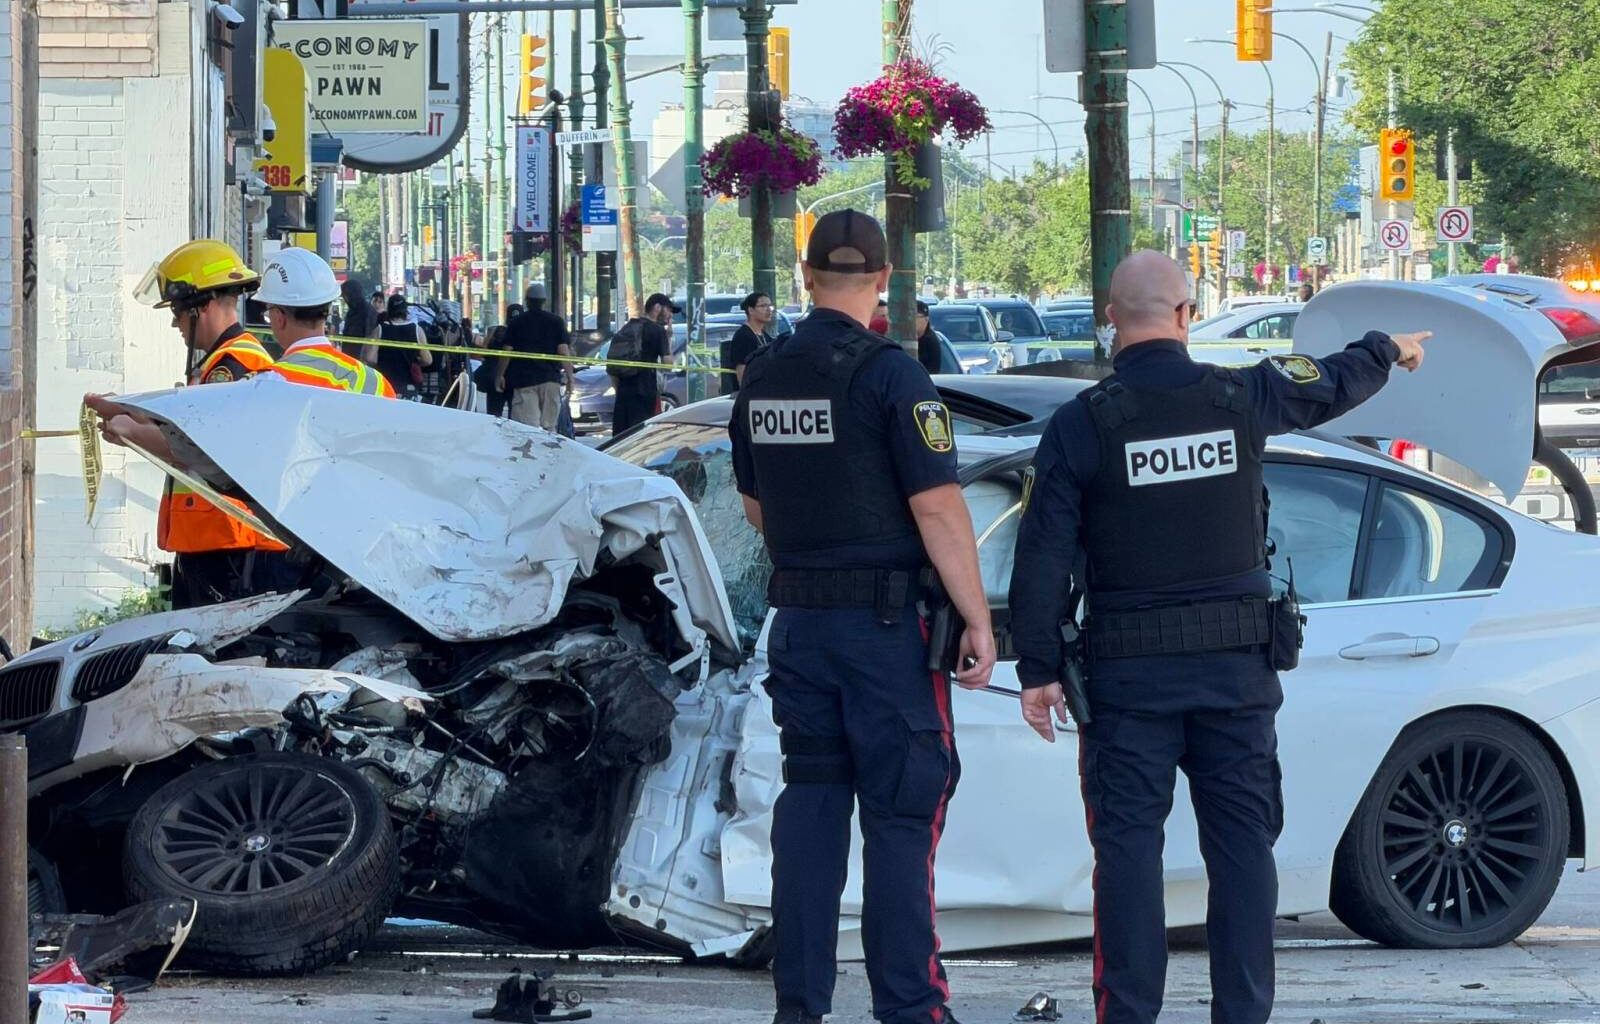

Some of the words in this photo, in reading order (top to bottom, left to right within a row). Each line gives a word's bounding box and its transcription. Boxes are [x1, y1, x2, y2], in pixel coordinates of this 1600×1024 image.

[317, 77, 382, 96] PAWN
[560, 131, 599, 143] DUFFERIN
[526, 152, 537, 213] WELCOME
[918, 403, 942, 412] POLICE
[751, 408, 830, 436] POLICE
[1130, 440, 1234, 477] POLICE
